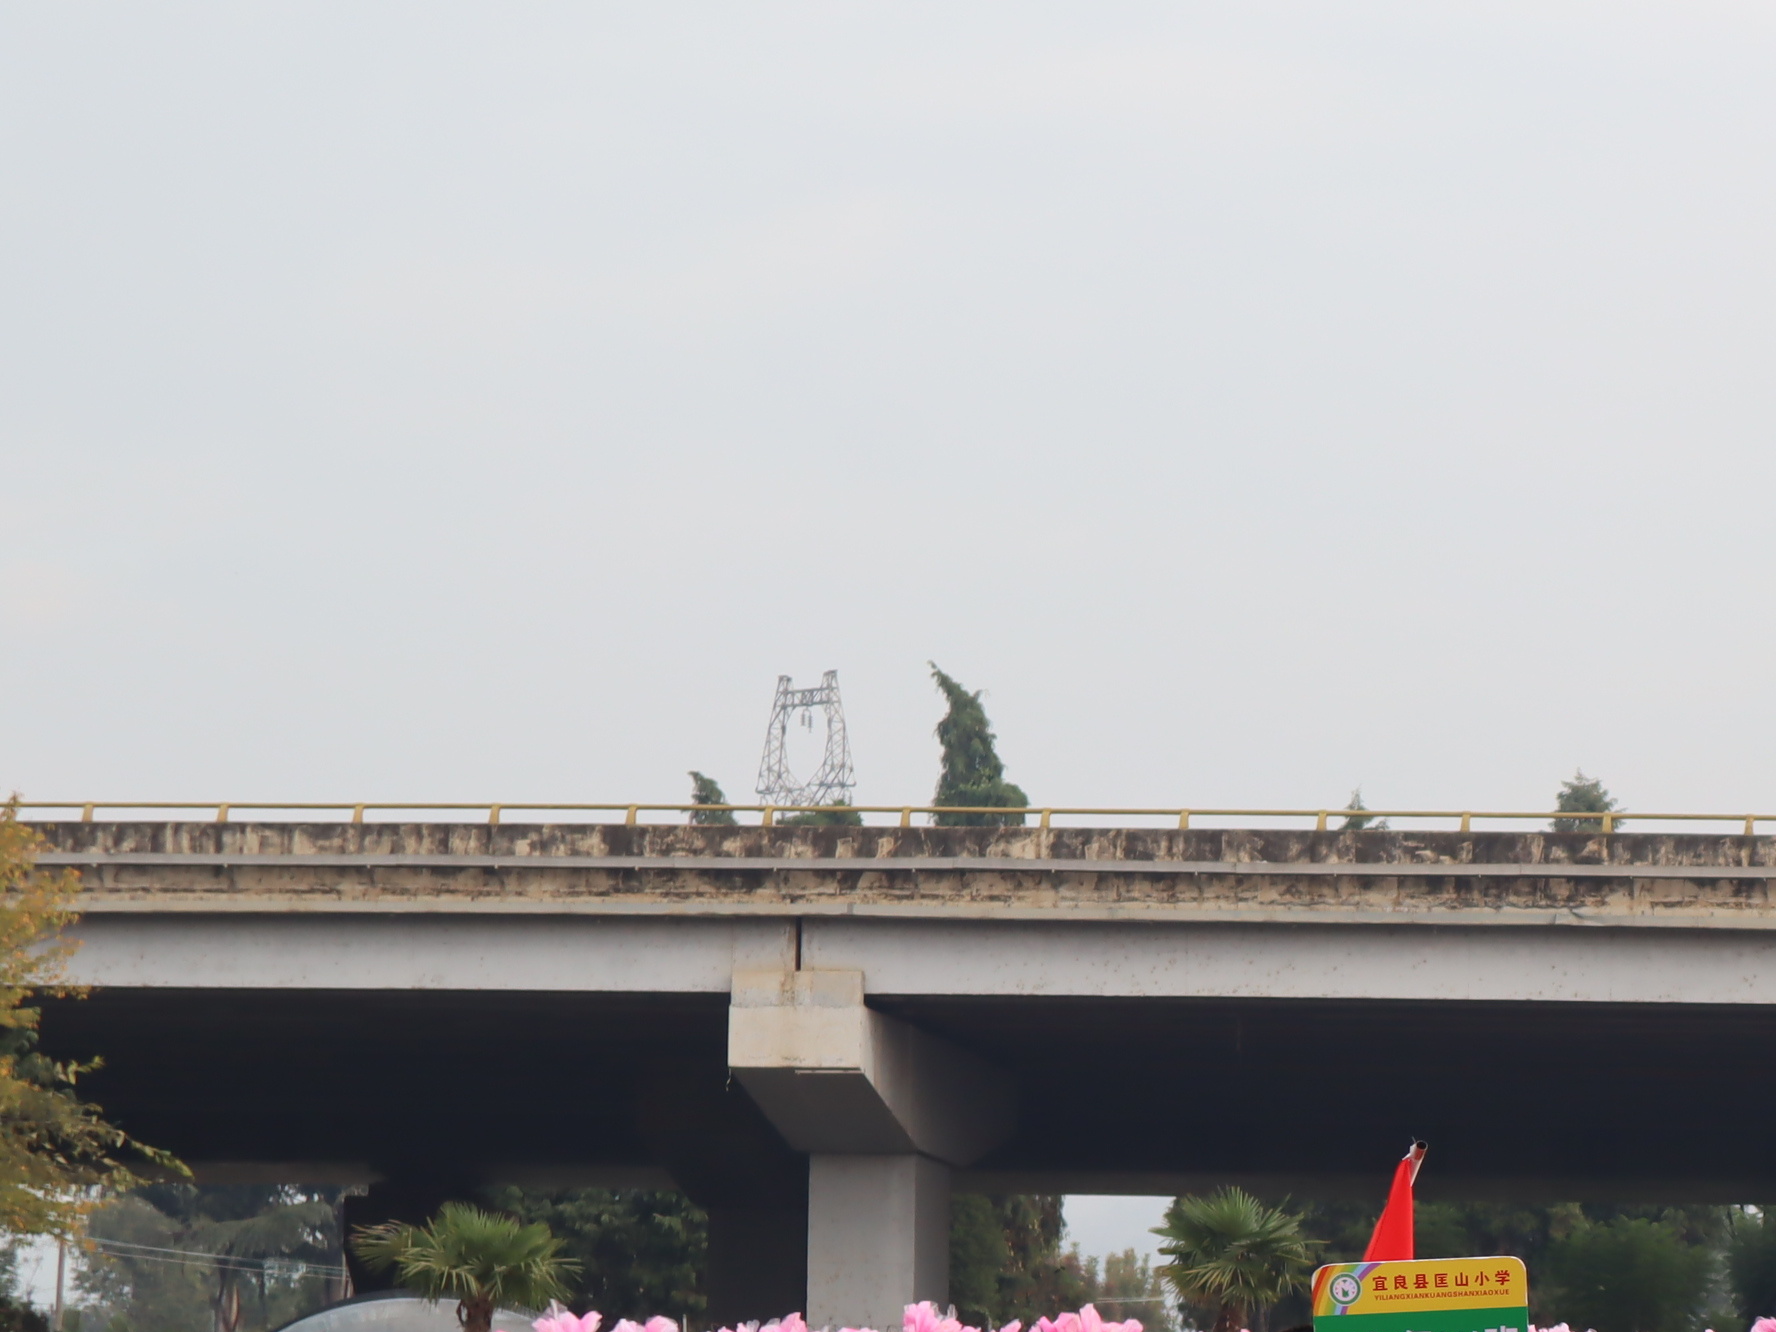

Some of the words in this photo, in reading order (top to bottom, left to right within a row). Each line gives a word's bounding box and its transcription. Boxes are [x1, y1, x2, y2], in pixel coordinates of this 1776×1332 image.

[1372, 1270, 1511, 1291] 宜良县匡山小学
[1374, 1289, 1510, 1301] YILIANGXIANKUANGSHANXIAOXUE
